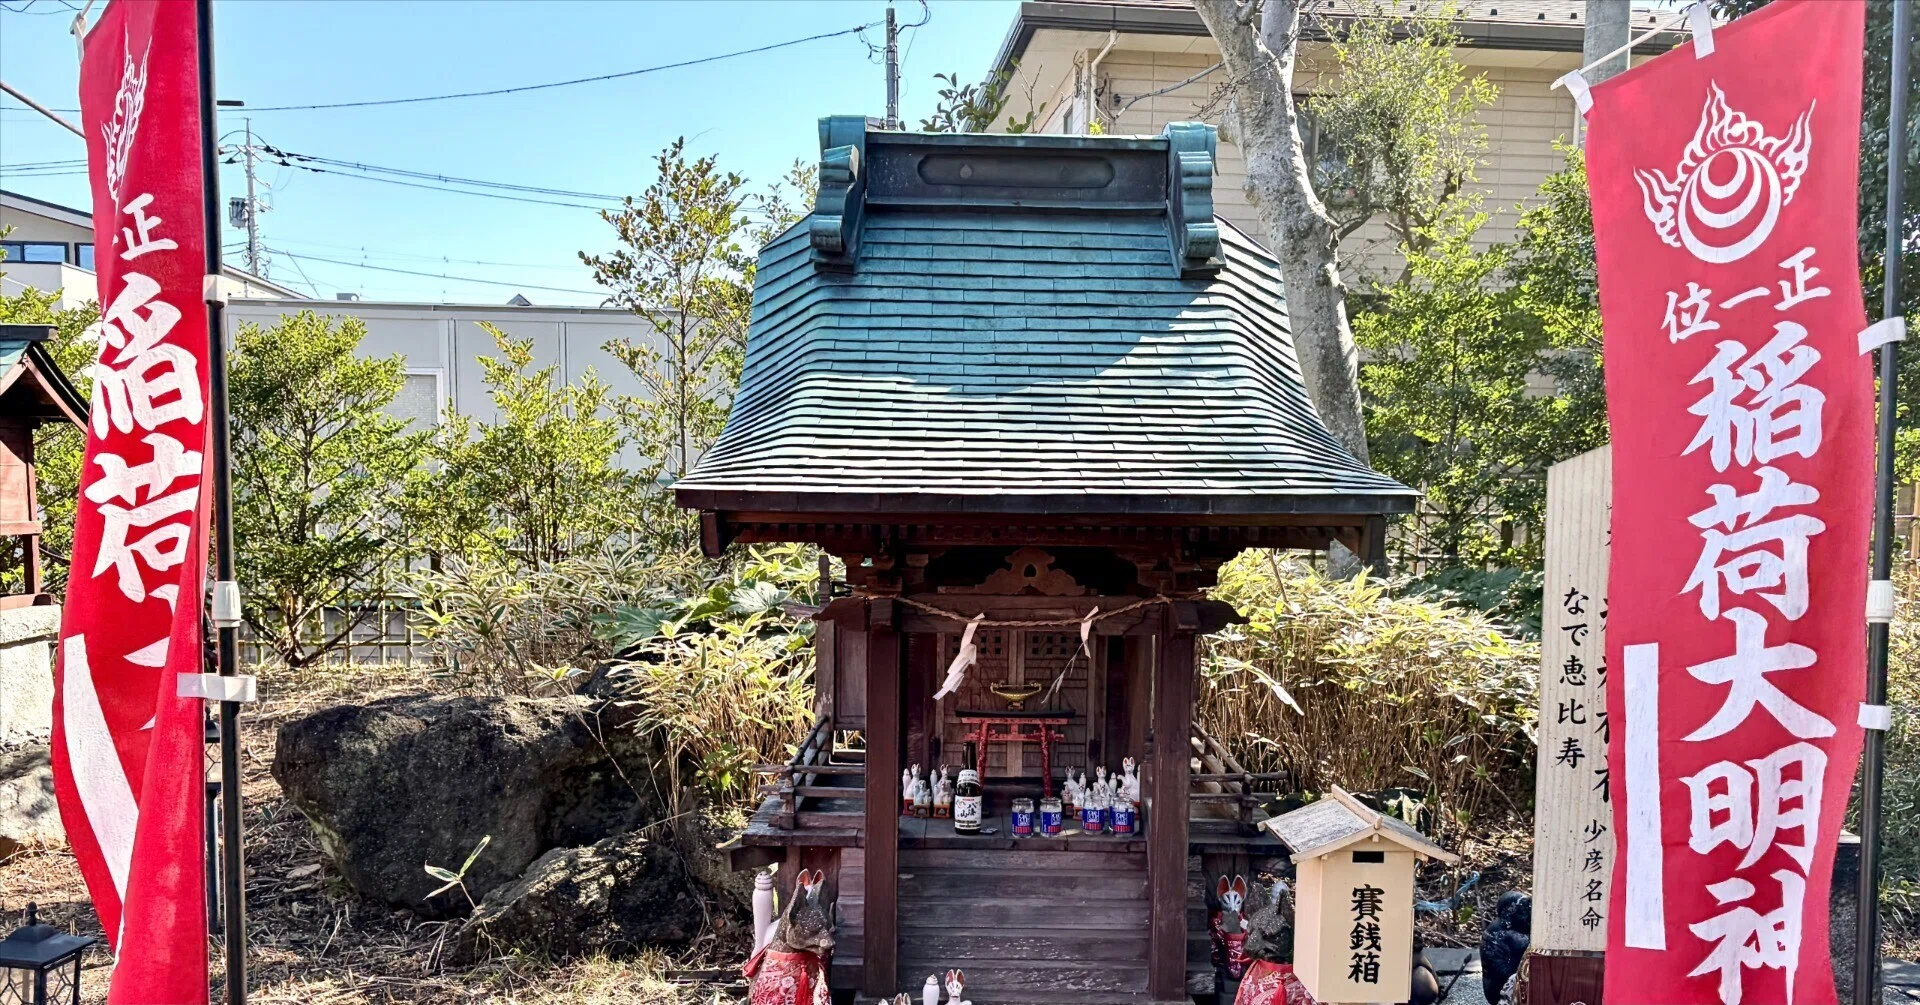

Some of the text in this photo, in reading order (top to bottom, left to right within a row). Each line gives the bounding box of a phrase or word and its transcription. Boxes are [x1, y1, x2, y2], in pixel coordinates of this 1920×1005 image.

[1661, 247, 1831, 344] 正一位
[1555, 586, 1590, 769] なで恵比寿
[1678, 321, 1836, 1005] 稲荷大明神
[1579, 819, 1607, 932] 少彦名命
[1347, 883, 1386, 985] 賽銭箱
